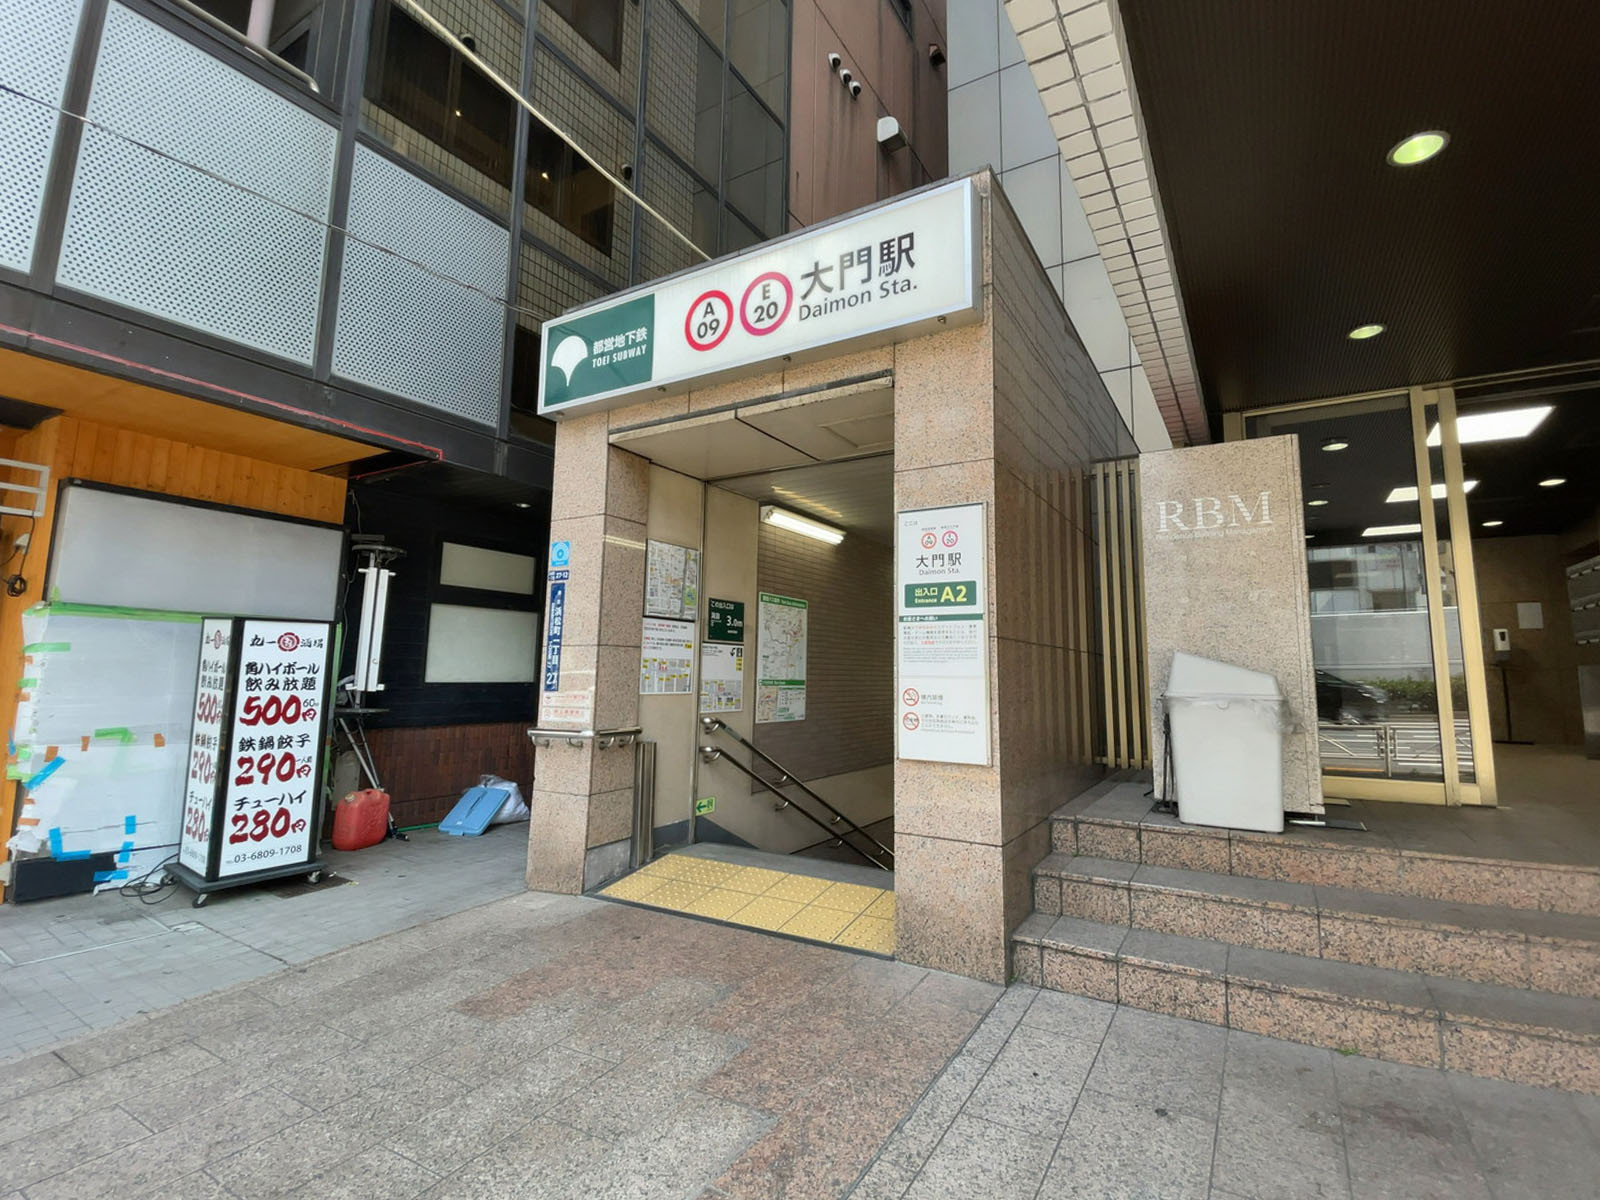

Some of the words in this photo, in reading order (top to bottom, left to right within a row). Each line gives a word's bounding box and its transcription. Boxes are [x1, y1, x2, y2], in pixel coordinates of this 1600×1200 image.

[800, 232, 915, 301] 大門駅
[762, 283, 771, 301] E
[799, 290, 872, 322] Daimon
[880, 278, 917, 299] Sta.
[703, 301, 715, 318] A
[754, 301, 778, 324] 20
[697, 318, 720, 339] 09
[593, 326, 647, 355] 都営地下鉄
[592, 355, 610, 368] TOEI
[612, 344, 646, 363] SUBWAY
[1156, 491, 1273, 532] RBM
[916, 552, 962, 568] 大門駅
[915, 587, 938, 597] 出入口
[940, 585, 967, 603] A2
[726, 615, 743, 628] 3.0m
[245, 661, 320, 675] 角ハイボール
[245, 676, 316, 692] 飲み放題
[239, 733, 311, 752] 鉄鍋餃子
[234, 790, 307, 811] チューハイ
[229, 807, 306, 845] 280円
[234, 845, 302, 864] 03-6809-1708
